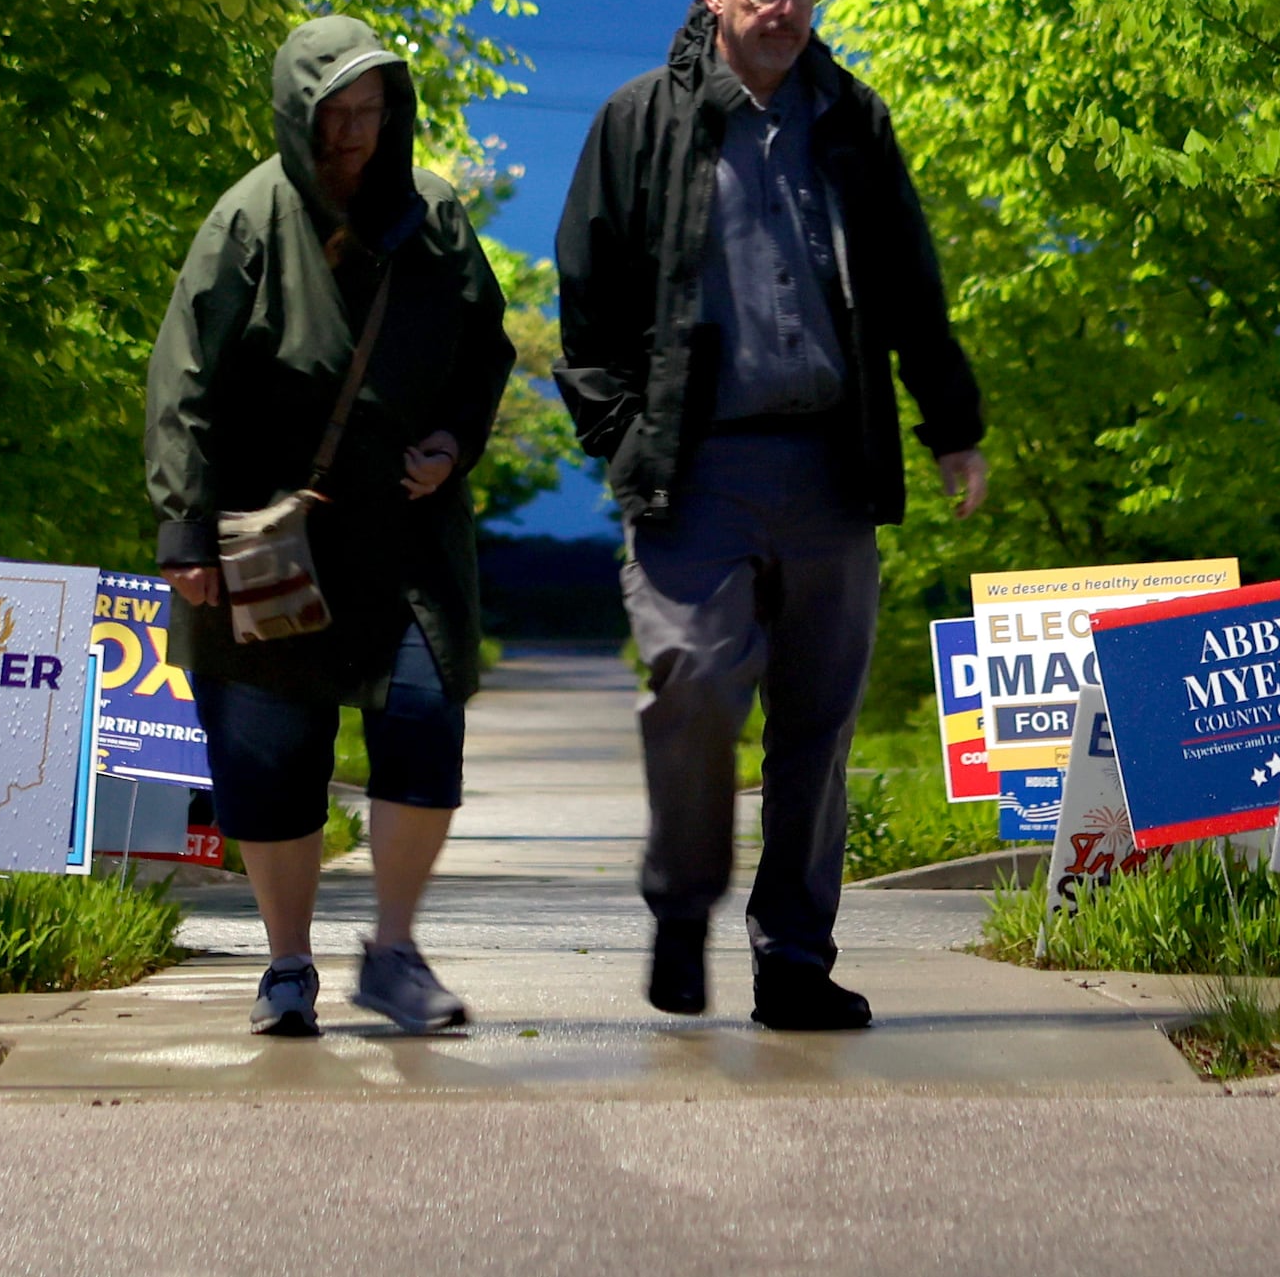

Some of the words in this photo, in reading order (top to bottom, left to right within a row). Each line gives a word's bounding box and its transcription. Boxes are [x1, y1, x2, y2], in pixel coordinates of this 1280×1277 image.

[987, 585, 1008, 596] We
[1012, 582, 1068, 595] deserve
[1072, 582, 1080, 591] a
[1085, 575, 1139, 591] healthy
[1143, 571, 1227, 587] democracy!
[988, 607, 1106, 644] ELEC
[1015, 710, 1069, 733] FOR
[1194, 704, 1273, 734] COUNTY
[1182, 741, 1244, 760] Experience
[1245, 734, 1265, 749] and
[206, 836, 220, 859] 2
